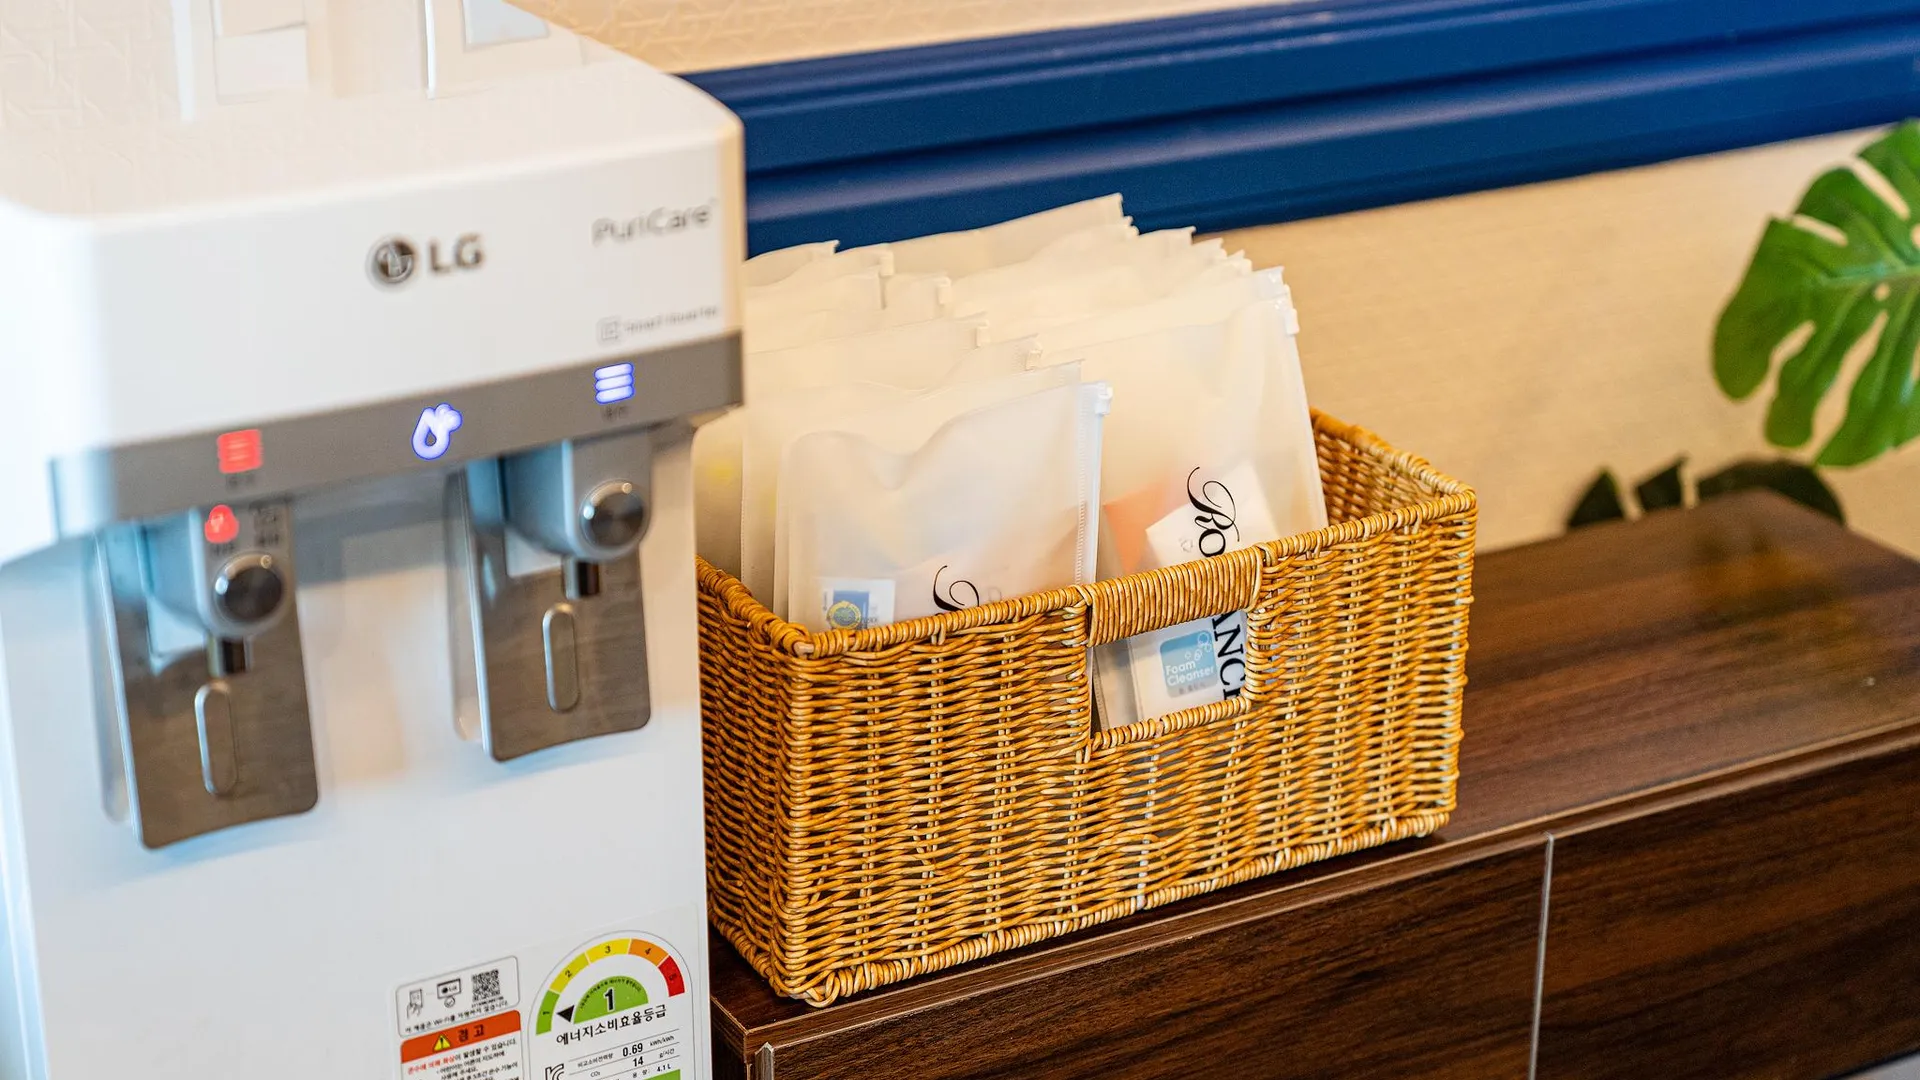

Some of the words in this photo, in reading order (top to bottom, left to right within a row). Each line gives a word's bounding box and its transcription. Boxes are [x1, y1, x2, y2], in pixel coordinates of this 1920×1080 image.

[592, 204, 711, 246] PuriCare
[429, 234, 484, 274] LG
[1165, 660, 1196, 676] Foam
[1166, 666, 1214, 686] Cleanser
[604, 945, 611, 953] 3
[644, 947, 651, 955] 4
[564, 969, 573, 978] 2
[604, 988, 614, 1011] 1
[556, 1004, 667, 1046] 에너지소비효율등급
[622, 1042, 643, 1057] 0.69
[632, 1056, 644, 1067] 14
[656, 1064, 666, 1072] 4.1
